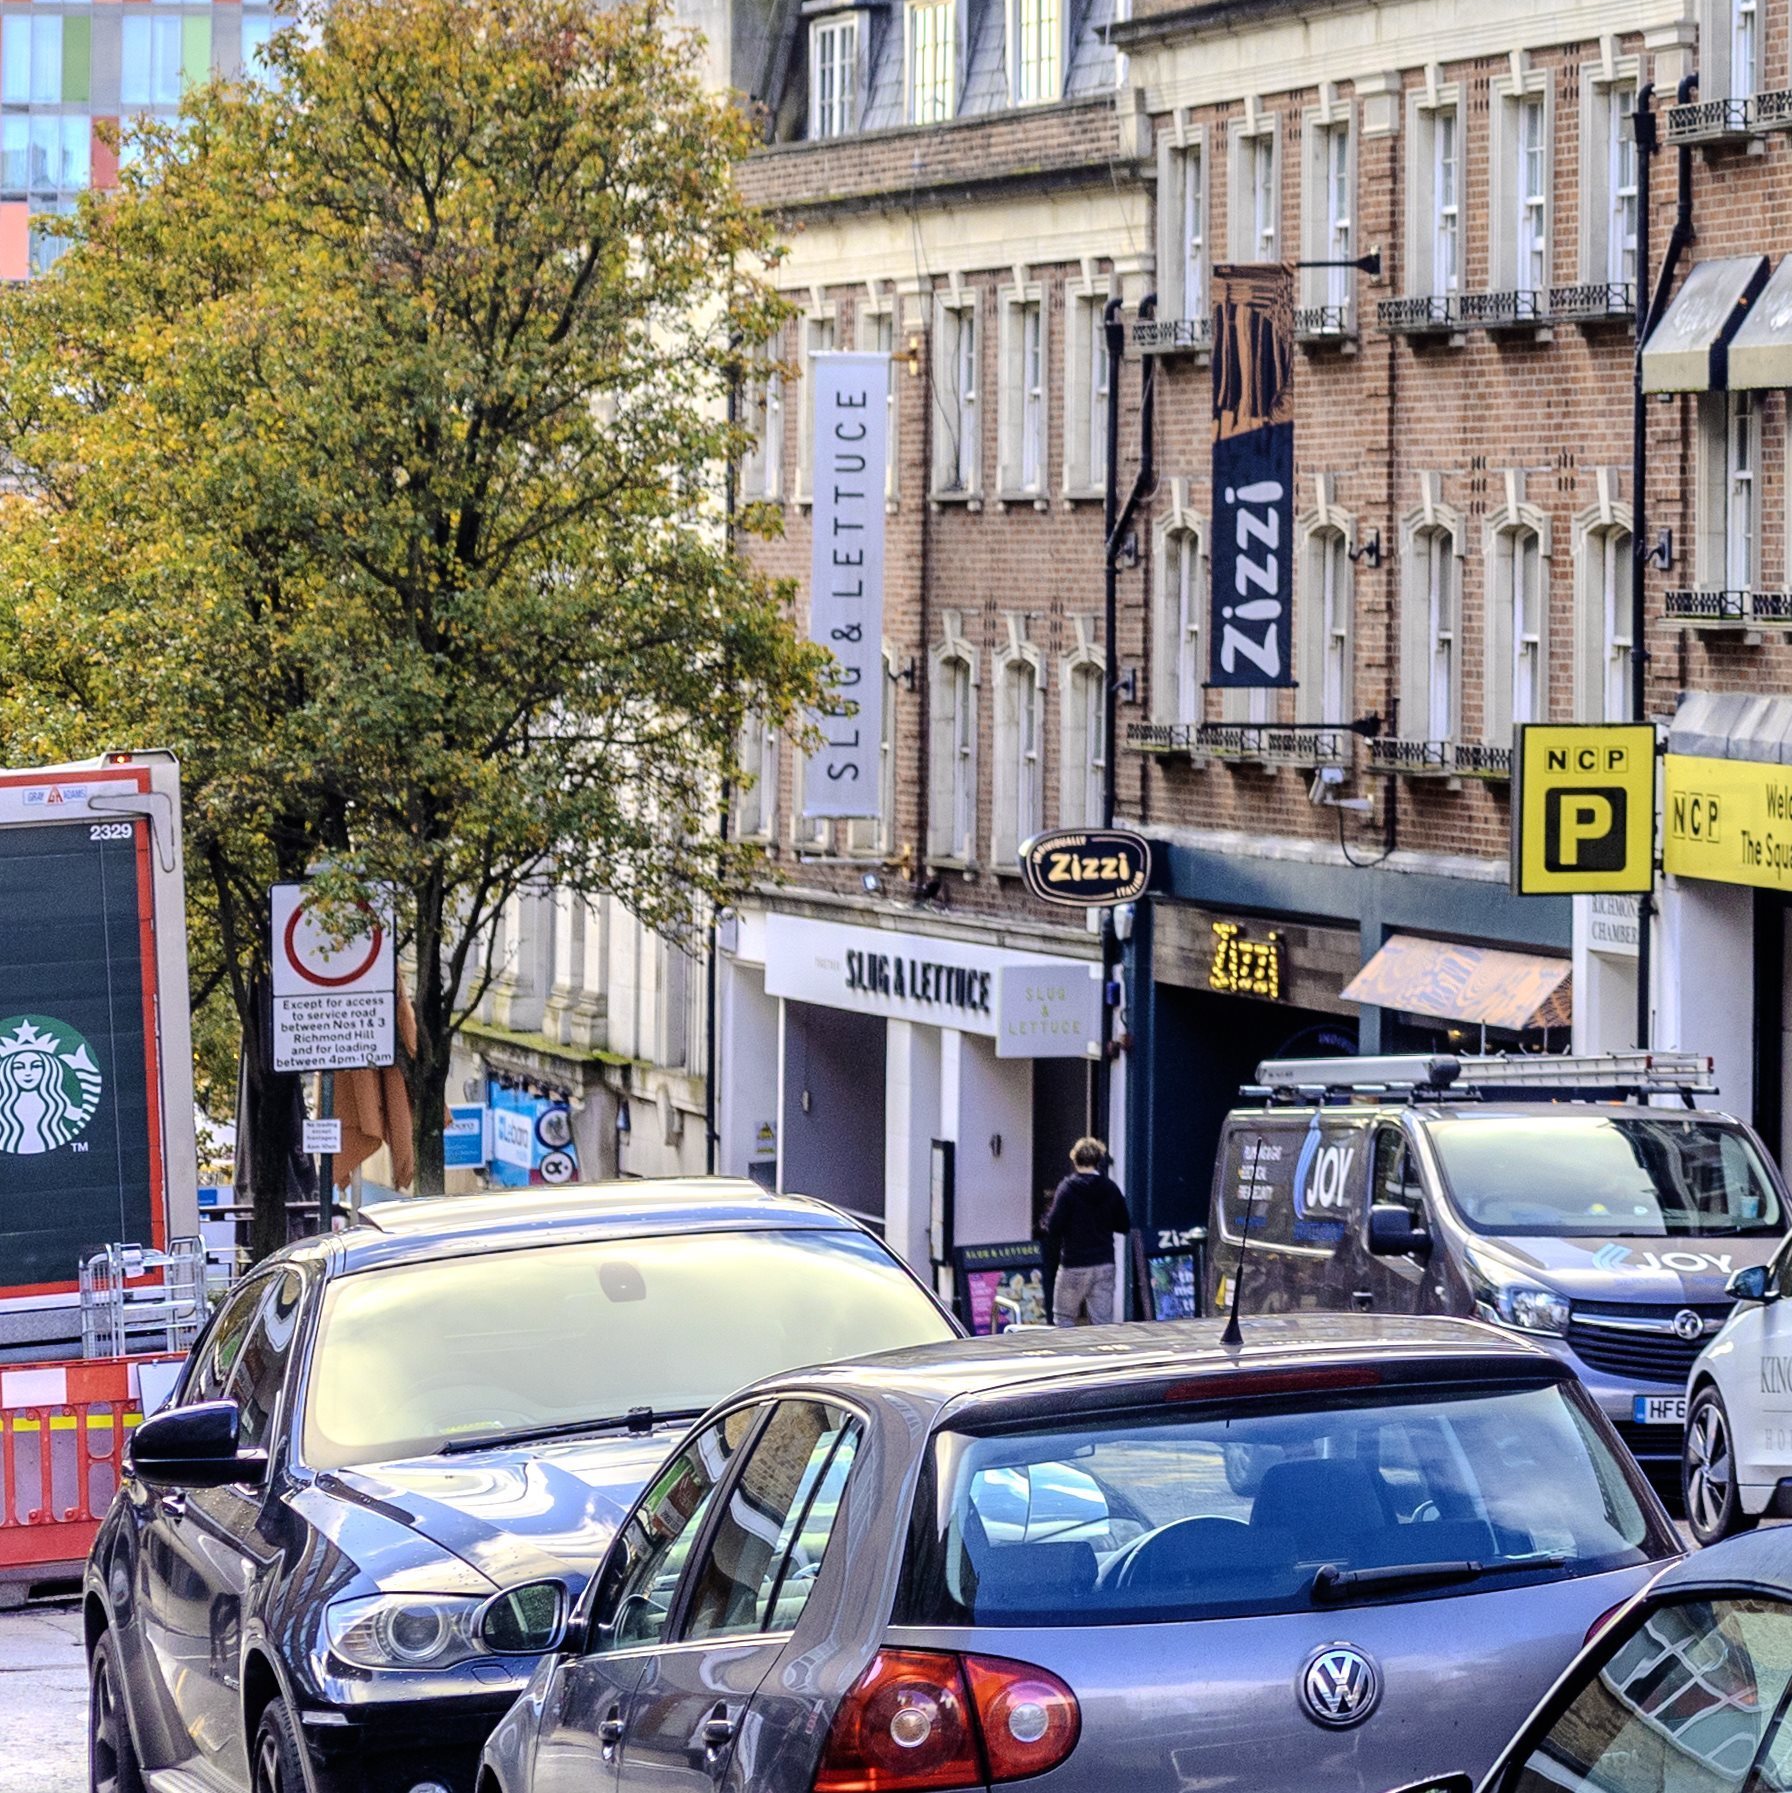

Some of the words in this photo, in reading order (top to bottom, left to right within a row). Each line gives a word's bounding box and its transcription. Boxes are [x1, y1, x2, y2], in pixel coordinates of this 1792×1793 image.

[832, 390, 867, 599] LETTUCE
[1220, 481, 1284, 679] Zizzi
[831, 622, 862, 643] &
[828, 664, 861, 781] SLUG
[1548, 750, 1625, 770] NCP
[1673, 795, 1719, 837] NCP
[90, 823, 132, 841] 2329
[1559, 794, 1613, 865] P
[1741, 830, 1763, 867] The
[1048, 852, 1130, 882] Zizzi
[1592, 895, 1637, 918] RICHMON
[1592, 921, 1639, 945] CHAMBER
[1209, 921, 1280, 1000] Zizzi
[845, 948, 890, 997] SLUG
[910, 960, 991, 1014] LETTUCE
[283, 998, 322, 1010] Except
[327, 998, 342, 1007] for
[346, 997, 384, 1007] access
[1026, 986, 1067, 1002] SLUG
[281, 1020, 330, 1032] between
[333, 1019, 356, 1030] Nos
[378, 1017, 386, 1028] 3
[292, 1011, 303, 1021] to
[307, 1009, 348, 1020] service
[351, 1008, 376, 1018] road
[293, 1032, 352, 1044] Richmond
[354, 1029, 375, 1040] Hill
[1008, 1020, 1082, 1036] LETTUCE
[291, 1045, 313, 1056] and
[316, 1044, 332, 1054] for
[335, 1042, 378, 1053] loading
[276, 1057, 326, 1068] between
[329, 1053, 392, 1065] 4pm-10am
[70, 1142, 89, 1152] TM
[1307, 1146, 1354, 1208] JOY
[1157, 1229, 1193, 1249] Ziz
[1636, 1252, 1733, 1273] JOY
[1650, 1400, 1686, 1419] HF6
